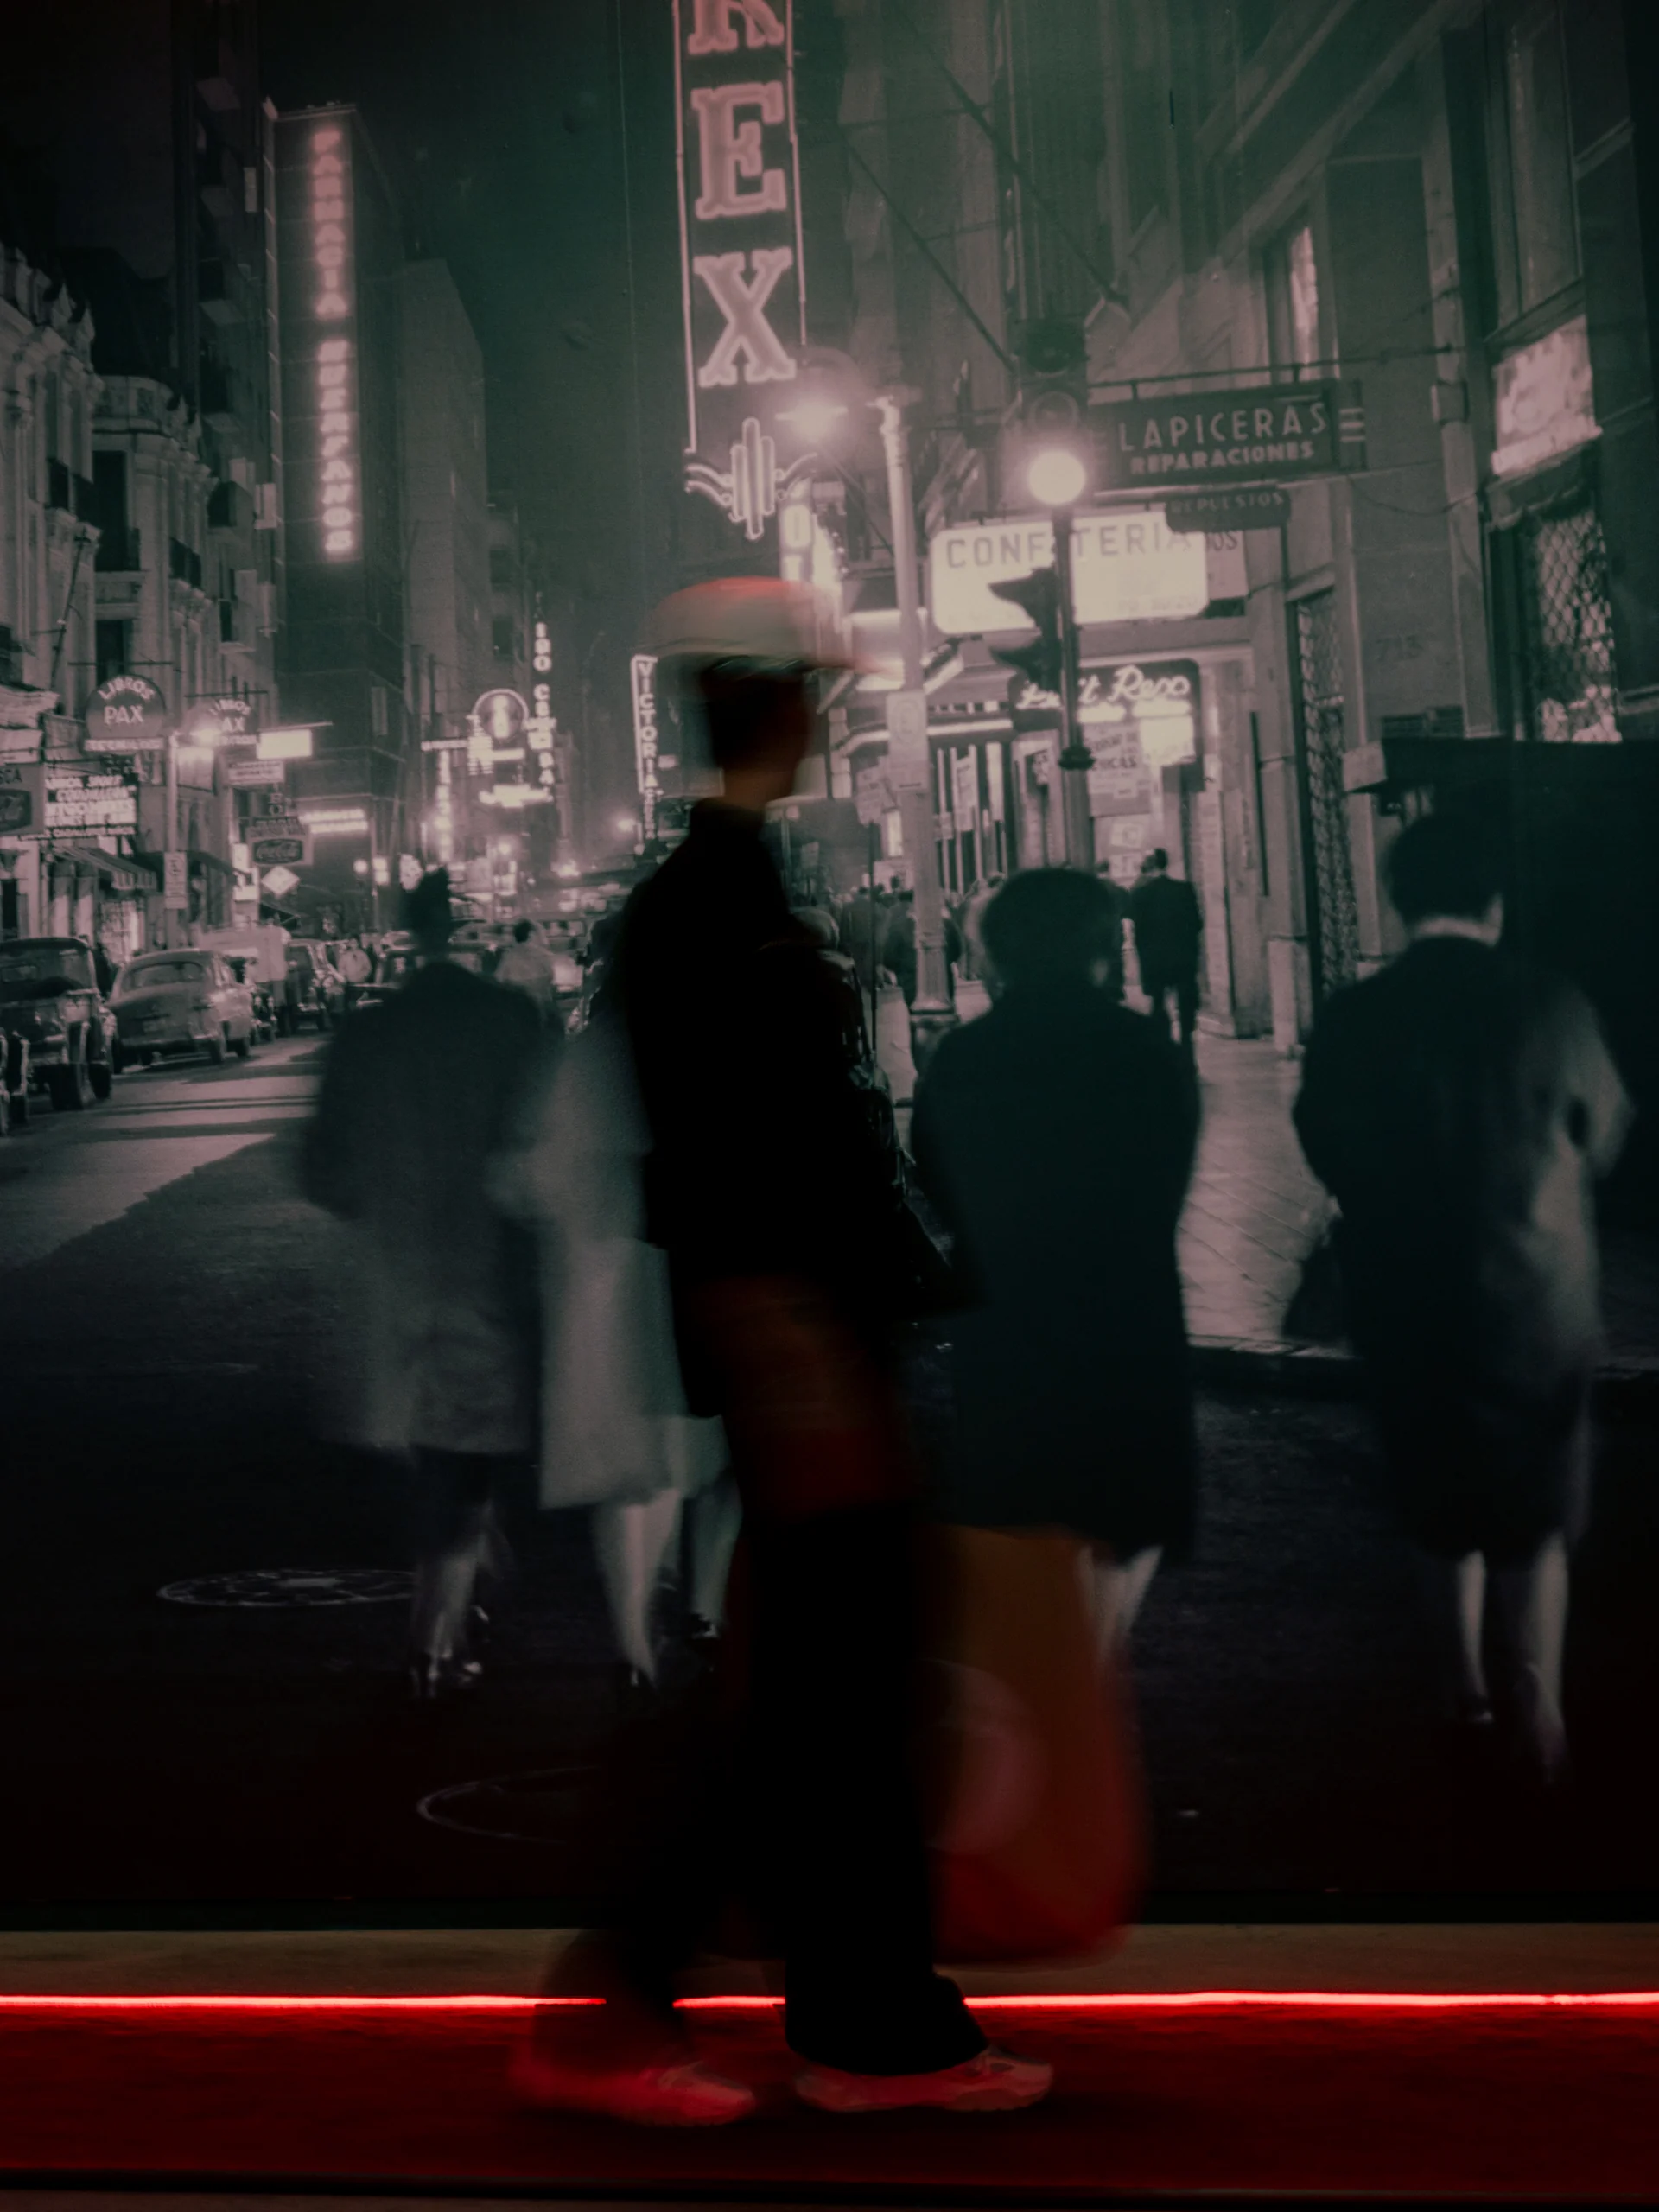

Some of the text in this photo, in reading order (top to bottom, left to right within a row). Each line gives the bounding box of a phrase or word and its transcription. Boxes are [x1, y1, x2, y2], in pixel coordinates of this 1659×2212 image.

[1120, 402, 1327, 452] LAPICERAS
[1130, 441, 1314, 476] REPARACIONES
[946, 523, 1192, 569] CONFTERIA
[97, 676, 155, 701] LIBROS
[104, 704, 144, 725] PAX
[638, 661, 658, 787] VICTORIA
